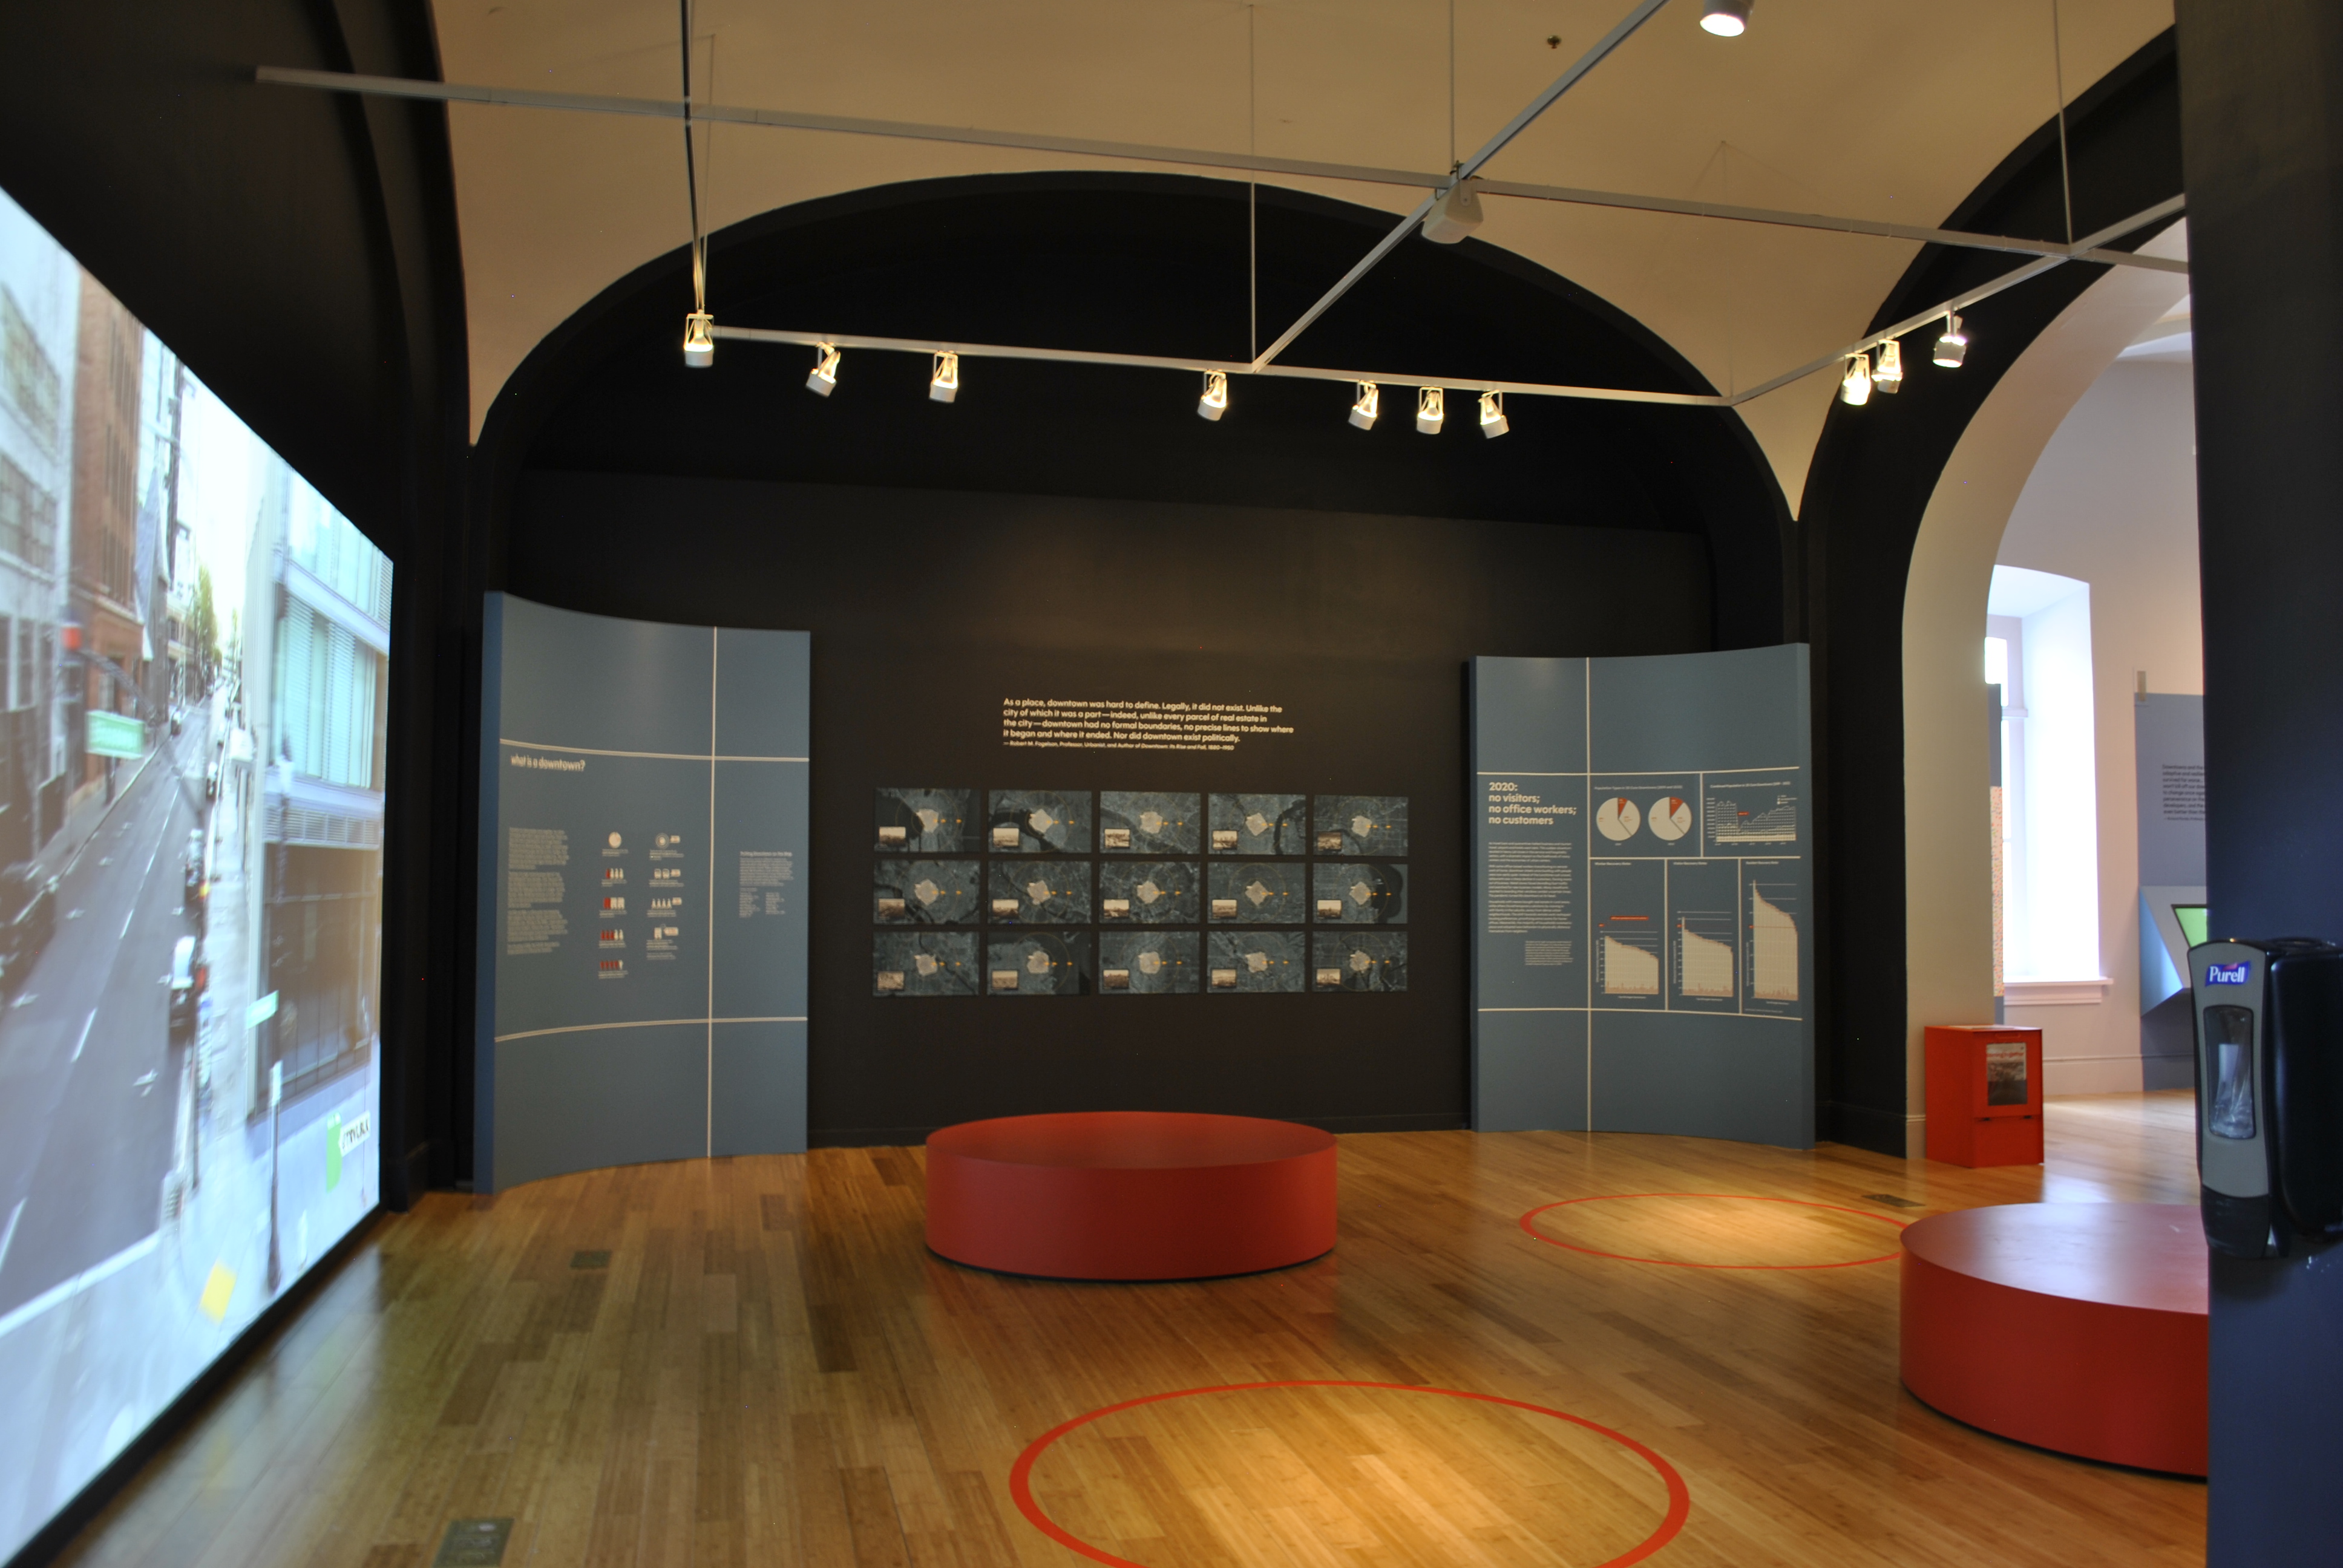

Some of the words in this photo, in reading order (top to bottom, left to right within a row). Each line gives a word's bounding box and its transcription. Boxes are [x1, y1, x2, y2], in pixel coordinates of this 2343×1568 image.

[1021, 699, 1046, 707] place,
[1162, 702, 1191, 711] Legally,
[1003, 709, 1018, 717] city
[1185, 713, 1210, 722] parcel
[1138, 722, 1182, 731] boundaries,
[1010, 730, 1035, 739] began
[1202, 734, 1240, 743] politically.
[511, 754, 525, 767] what
[527, 754, 532, 768] is
[533, 758, 537, 768] a
[539, 756, 585, 772] downtown?
[1489, 782, 1518, 791] 2020:
[1502, 793, 1541, 804] visitors;
[1502, 804, 1532, 813] office
[1533, 805, 1577, 815] workers;
[1502, 816, 1554, 825] customers
[2209, 966, 2245, 982] Purell
